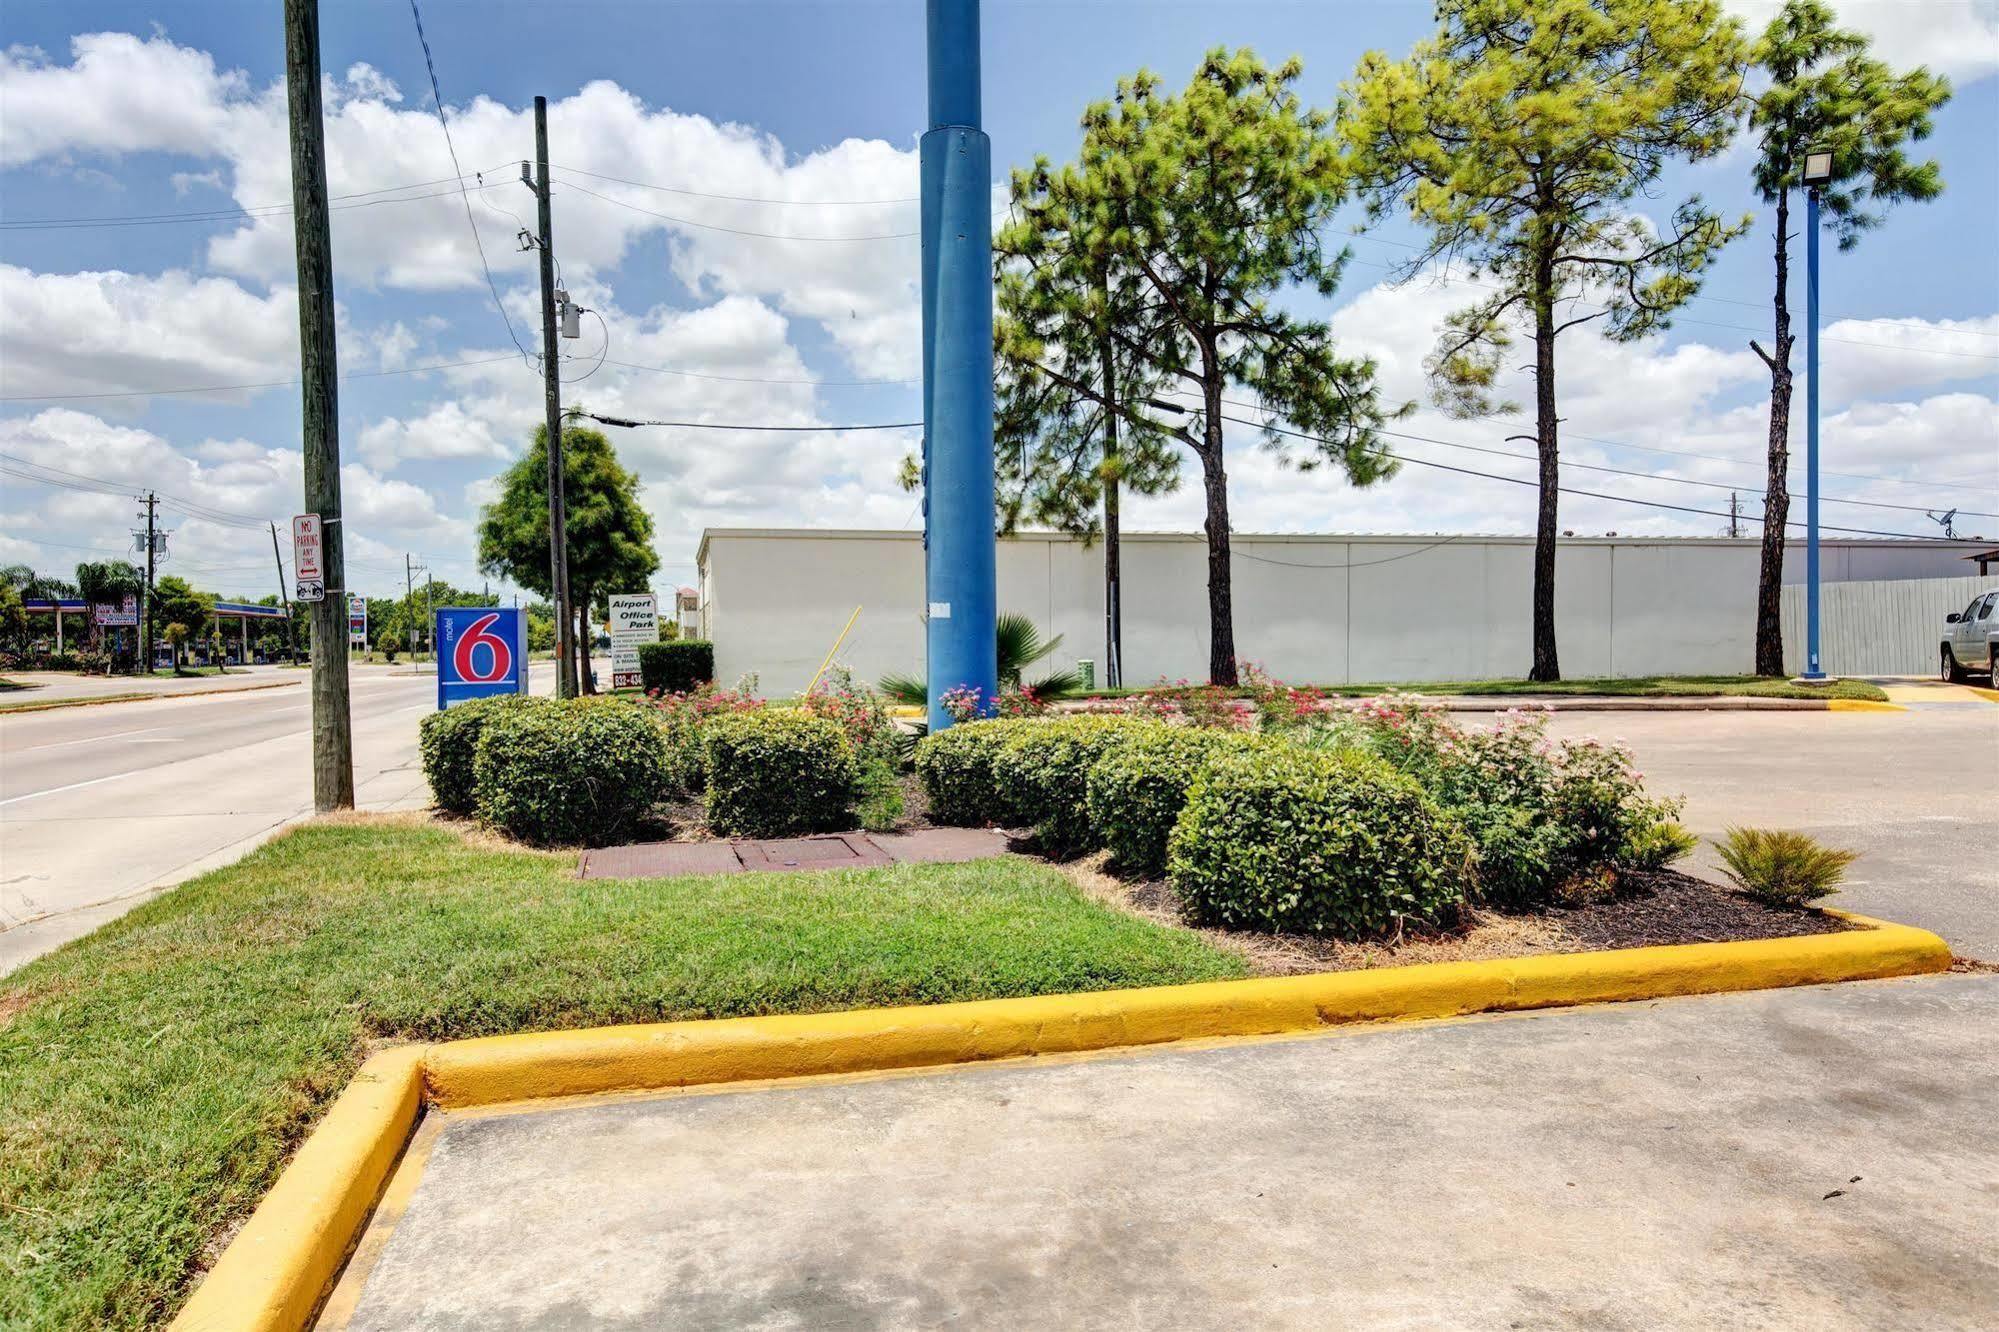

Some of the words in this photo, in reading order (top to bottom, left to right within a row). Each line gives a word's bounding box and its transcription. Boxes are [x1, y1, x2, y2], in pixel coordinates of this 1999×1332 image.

[301, 521, 312, 533] NO
[297, 535, 318, 548] PARKING
[302, 548, 313, 557] ANY
[303, 558, 314, 567] TIME
[612, 600, 651, 610] Airport
[620, 611, 653, 620] Office
[444, 618, 453, 641] motel
[629, 620, 654, 629] Park
[453, 612, 512, 684] 6
